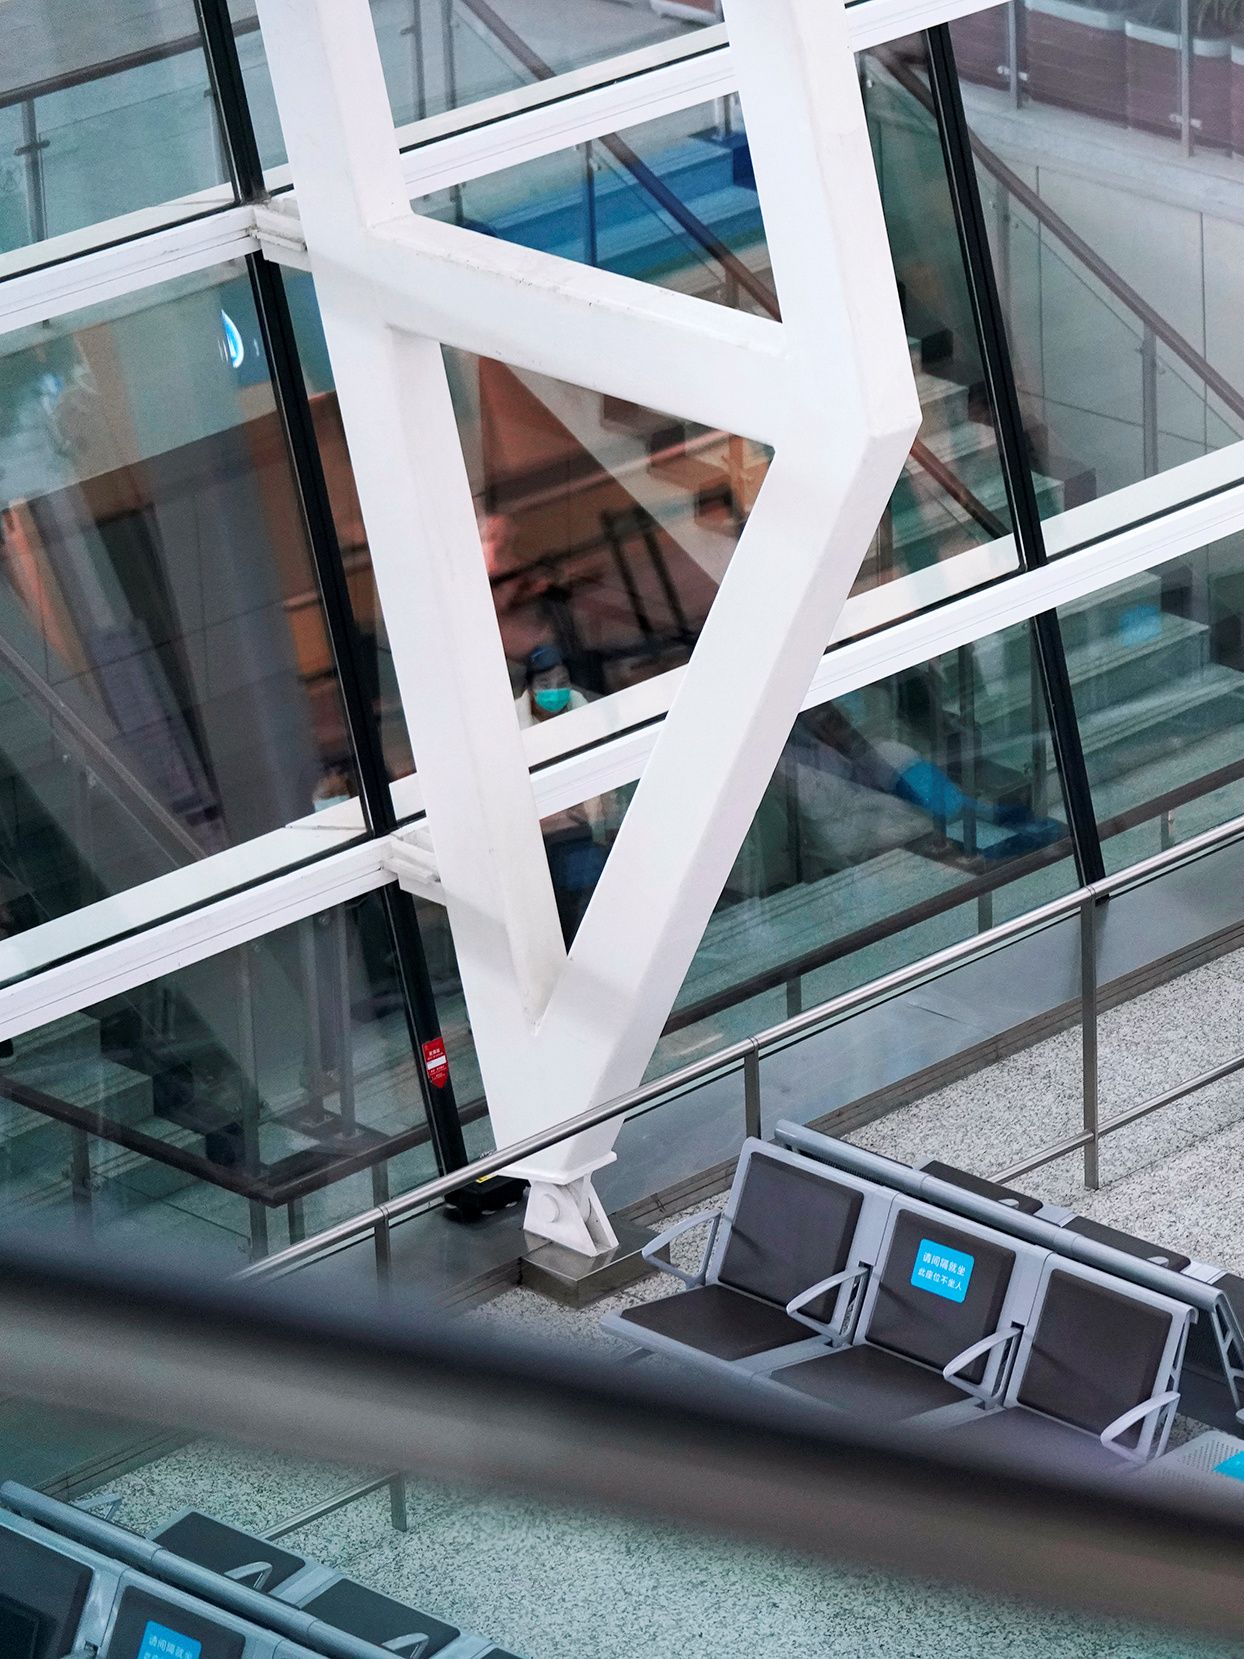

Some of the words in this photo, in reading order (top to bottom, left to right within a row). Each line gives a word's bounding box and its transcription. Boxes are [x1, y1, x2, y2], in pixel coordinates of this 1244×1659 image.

[922, 1252, 966, 1276] 请间隔就坐
